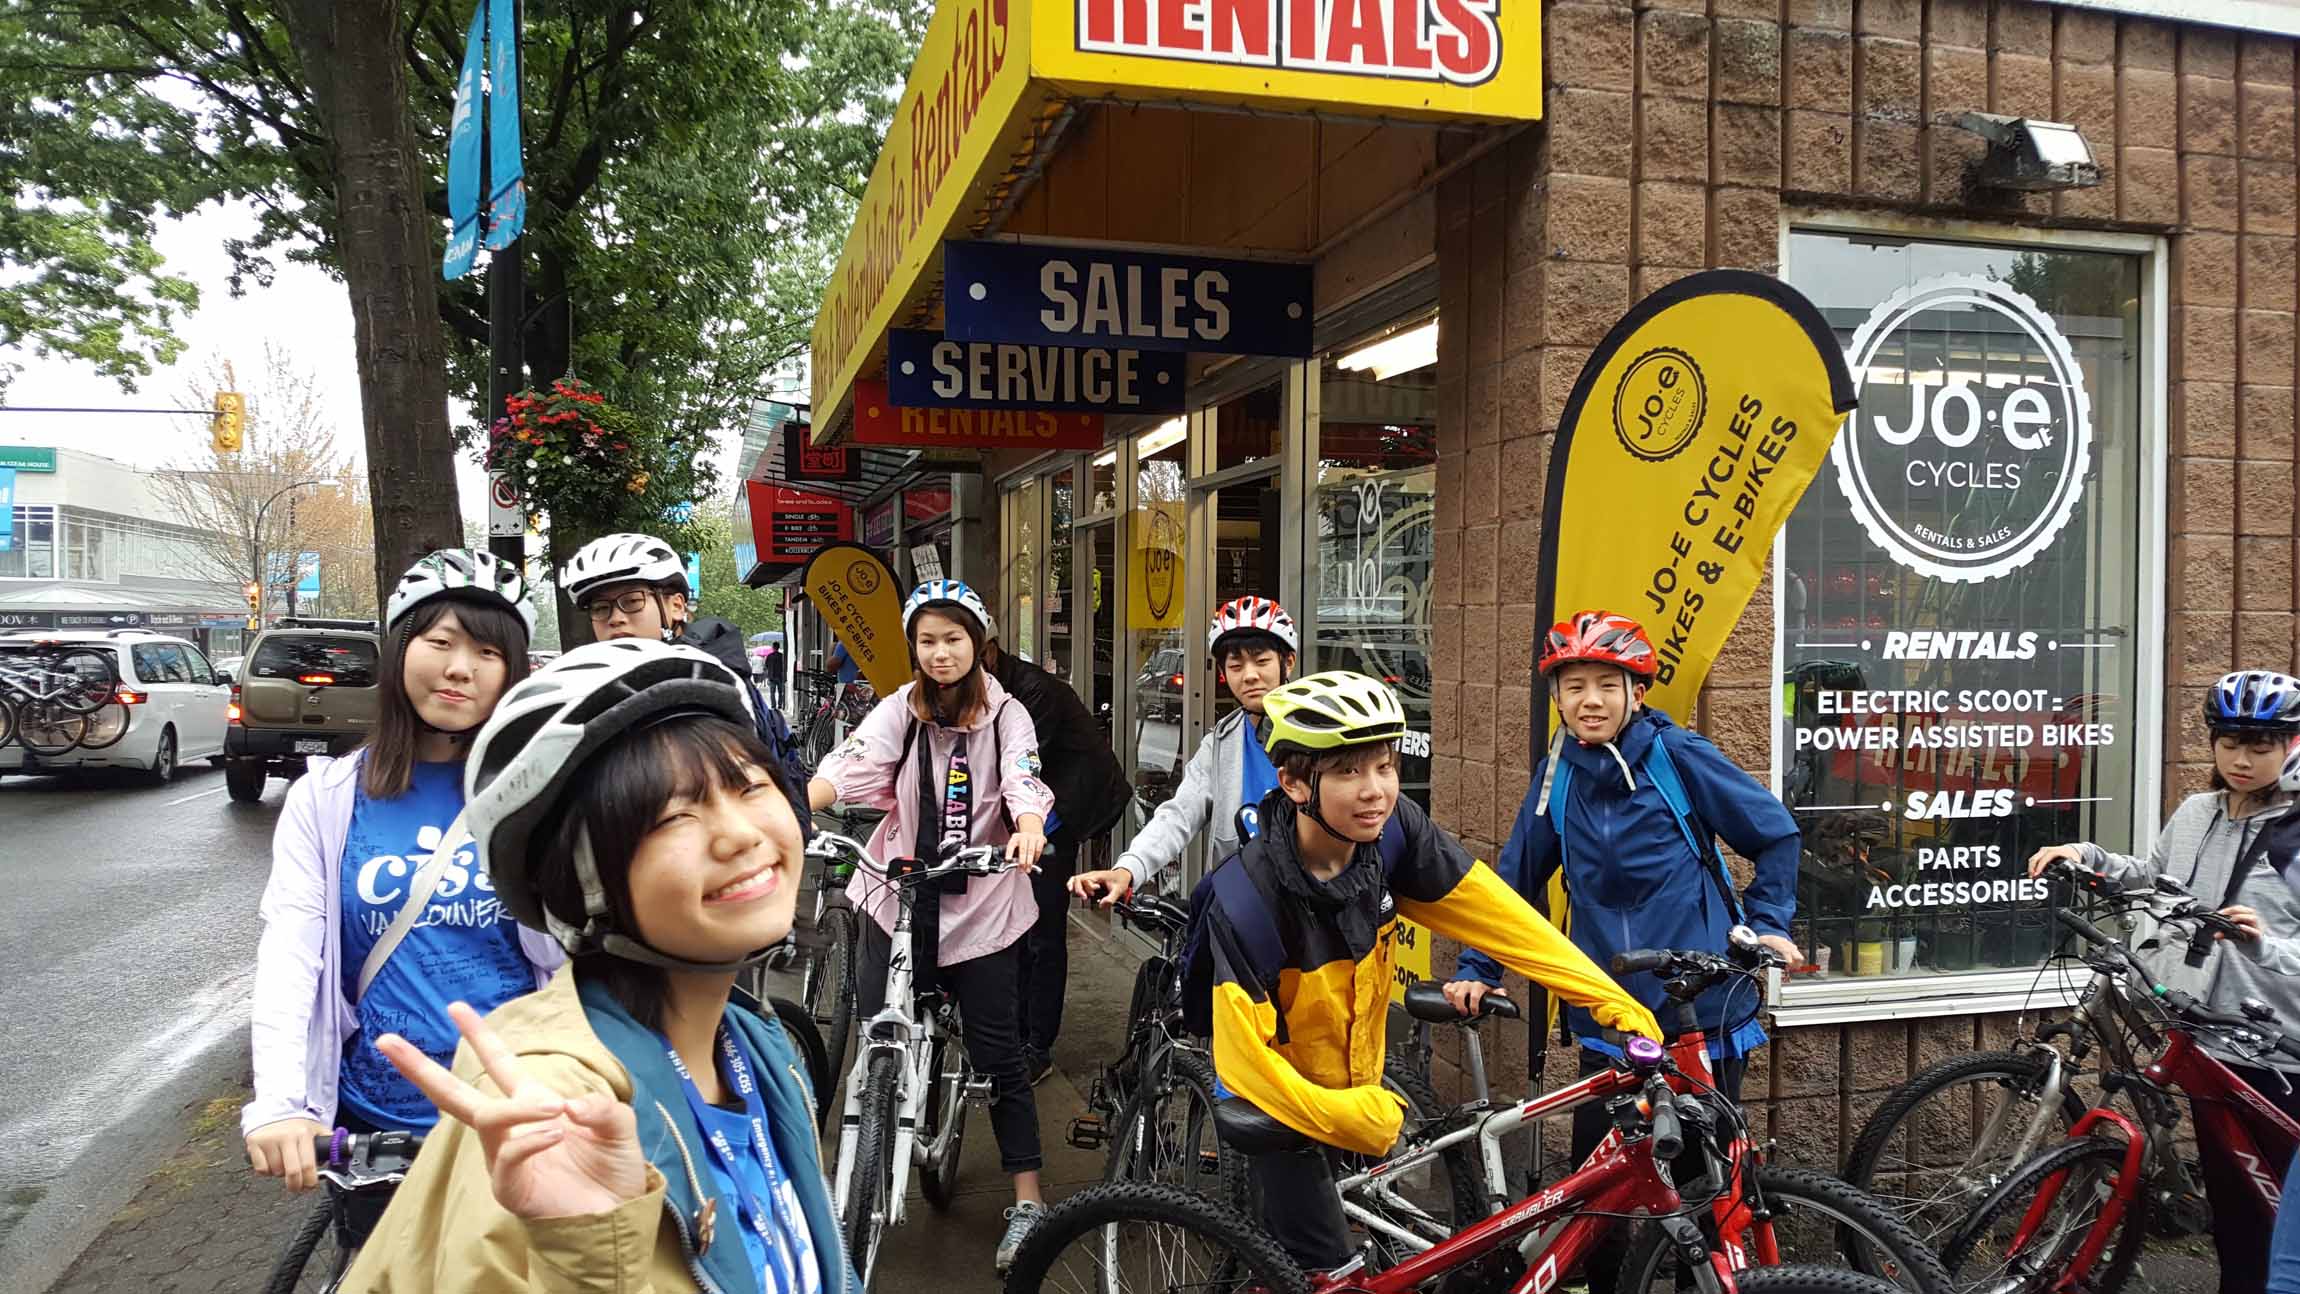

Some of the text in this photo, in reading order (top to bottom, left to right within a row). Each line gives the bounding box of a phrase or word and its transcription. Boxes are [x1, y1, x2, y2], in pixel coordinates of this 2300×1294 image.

[908, 0, 1009, 242] Rentals
[1040, 259, 1230, 341] SALES
[931, 340, 1140, 405] SERVICE
[901, 408, 1057, 438] RENTALS
[1657, 387, 1685, 436] CYCLES
[1906, 460, 2021, 489] CYCLES
[1644, 393, 1765, 615] JO-E CYCLES
[1655, 415, 1799, 688] BIKES & E-BIKES
[1915, 523, 2012, 548] RENTALS & SALES
[818, 584, 842, 615] BIKES
[846, 623, 876, 663] E-BIKES
[828, 579, 875, 641] JO-E CYCLES
[1882, 631, 2039, 660] RENTALS
[1817, 690, 1950, 715] ELECTRIC
[1795, 723, 2115, 751] POWER ASSISTED BIKES
[1905, 789, 2016, 821] SALES
[1918, 845, 2001, 870] PARTS
[1866, 878, 2049, 909] ACCESSORIES
[361, 897, 515, 936] VAOUVER
[2233, 1150, 2282, 1210] NO
